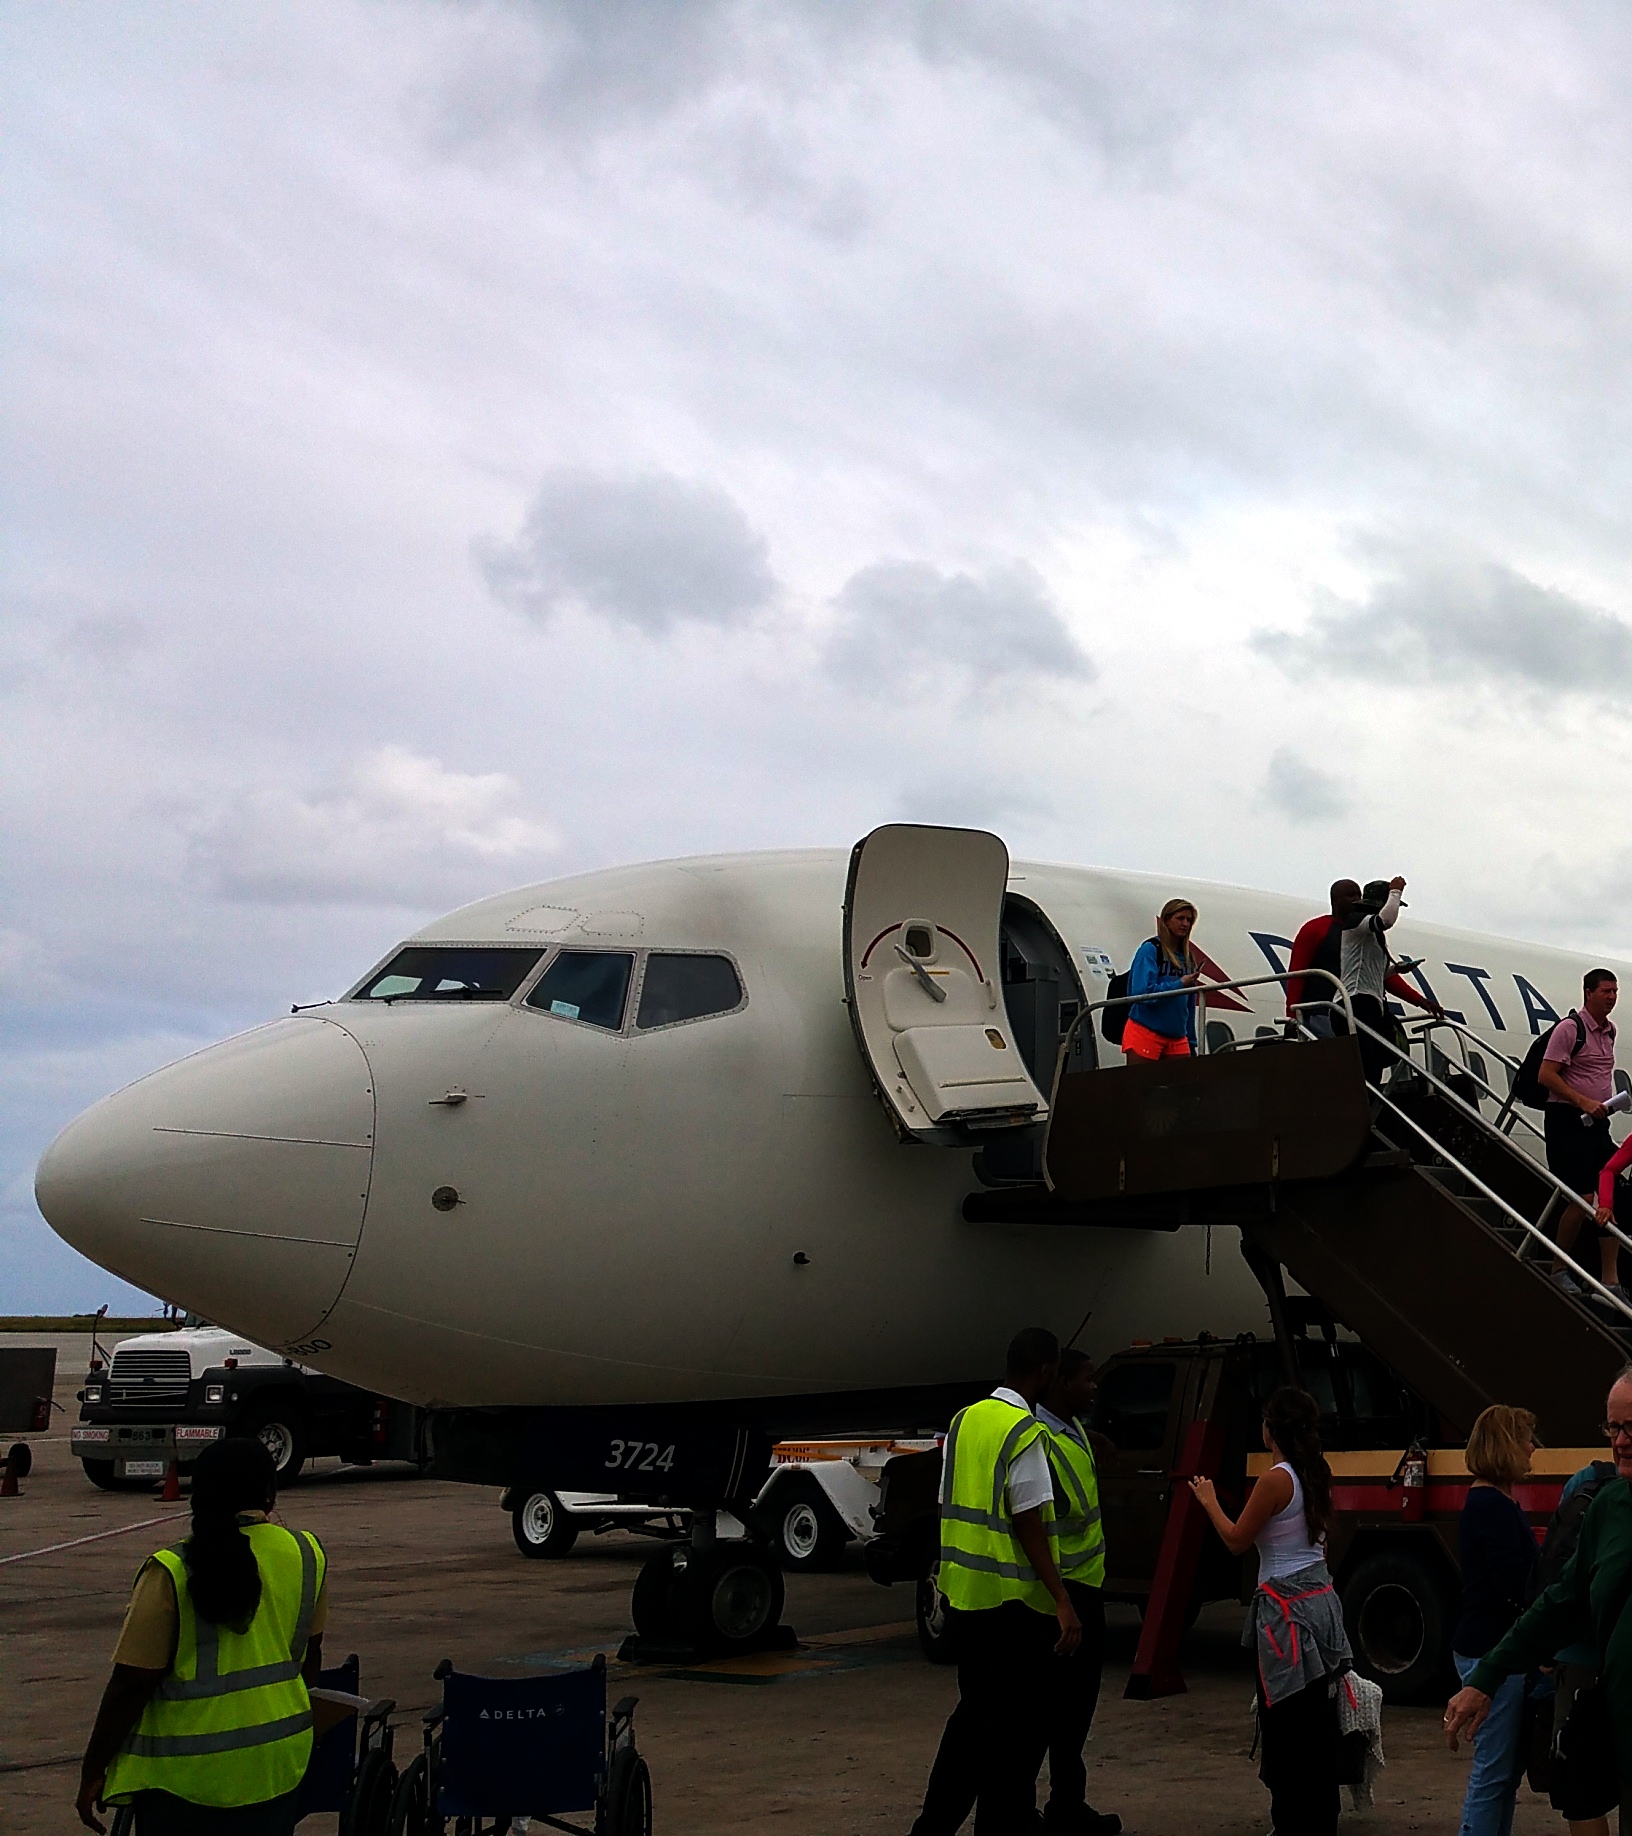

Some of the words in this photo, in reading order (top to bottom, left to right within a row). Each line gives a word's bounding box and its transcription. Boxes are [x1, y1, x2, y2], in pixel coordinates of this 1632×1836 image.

[73, 1430, 81, 1440] NO
[82, 1430, 108, 1440] SMOKING
[132, 1430, 150, 1440] 863
[176, 1428, 218, 1439] FLAMMABLE
[604, 1439, 675, 1472] 3724
[494, 1707, 546, 1720] DELTA
